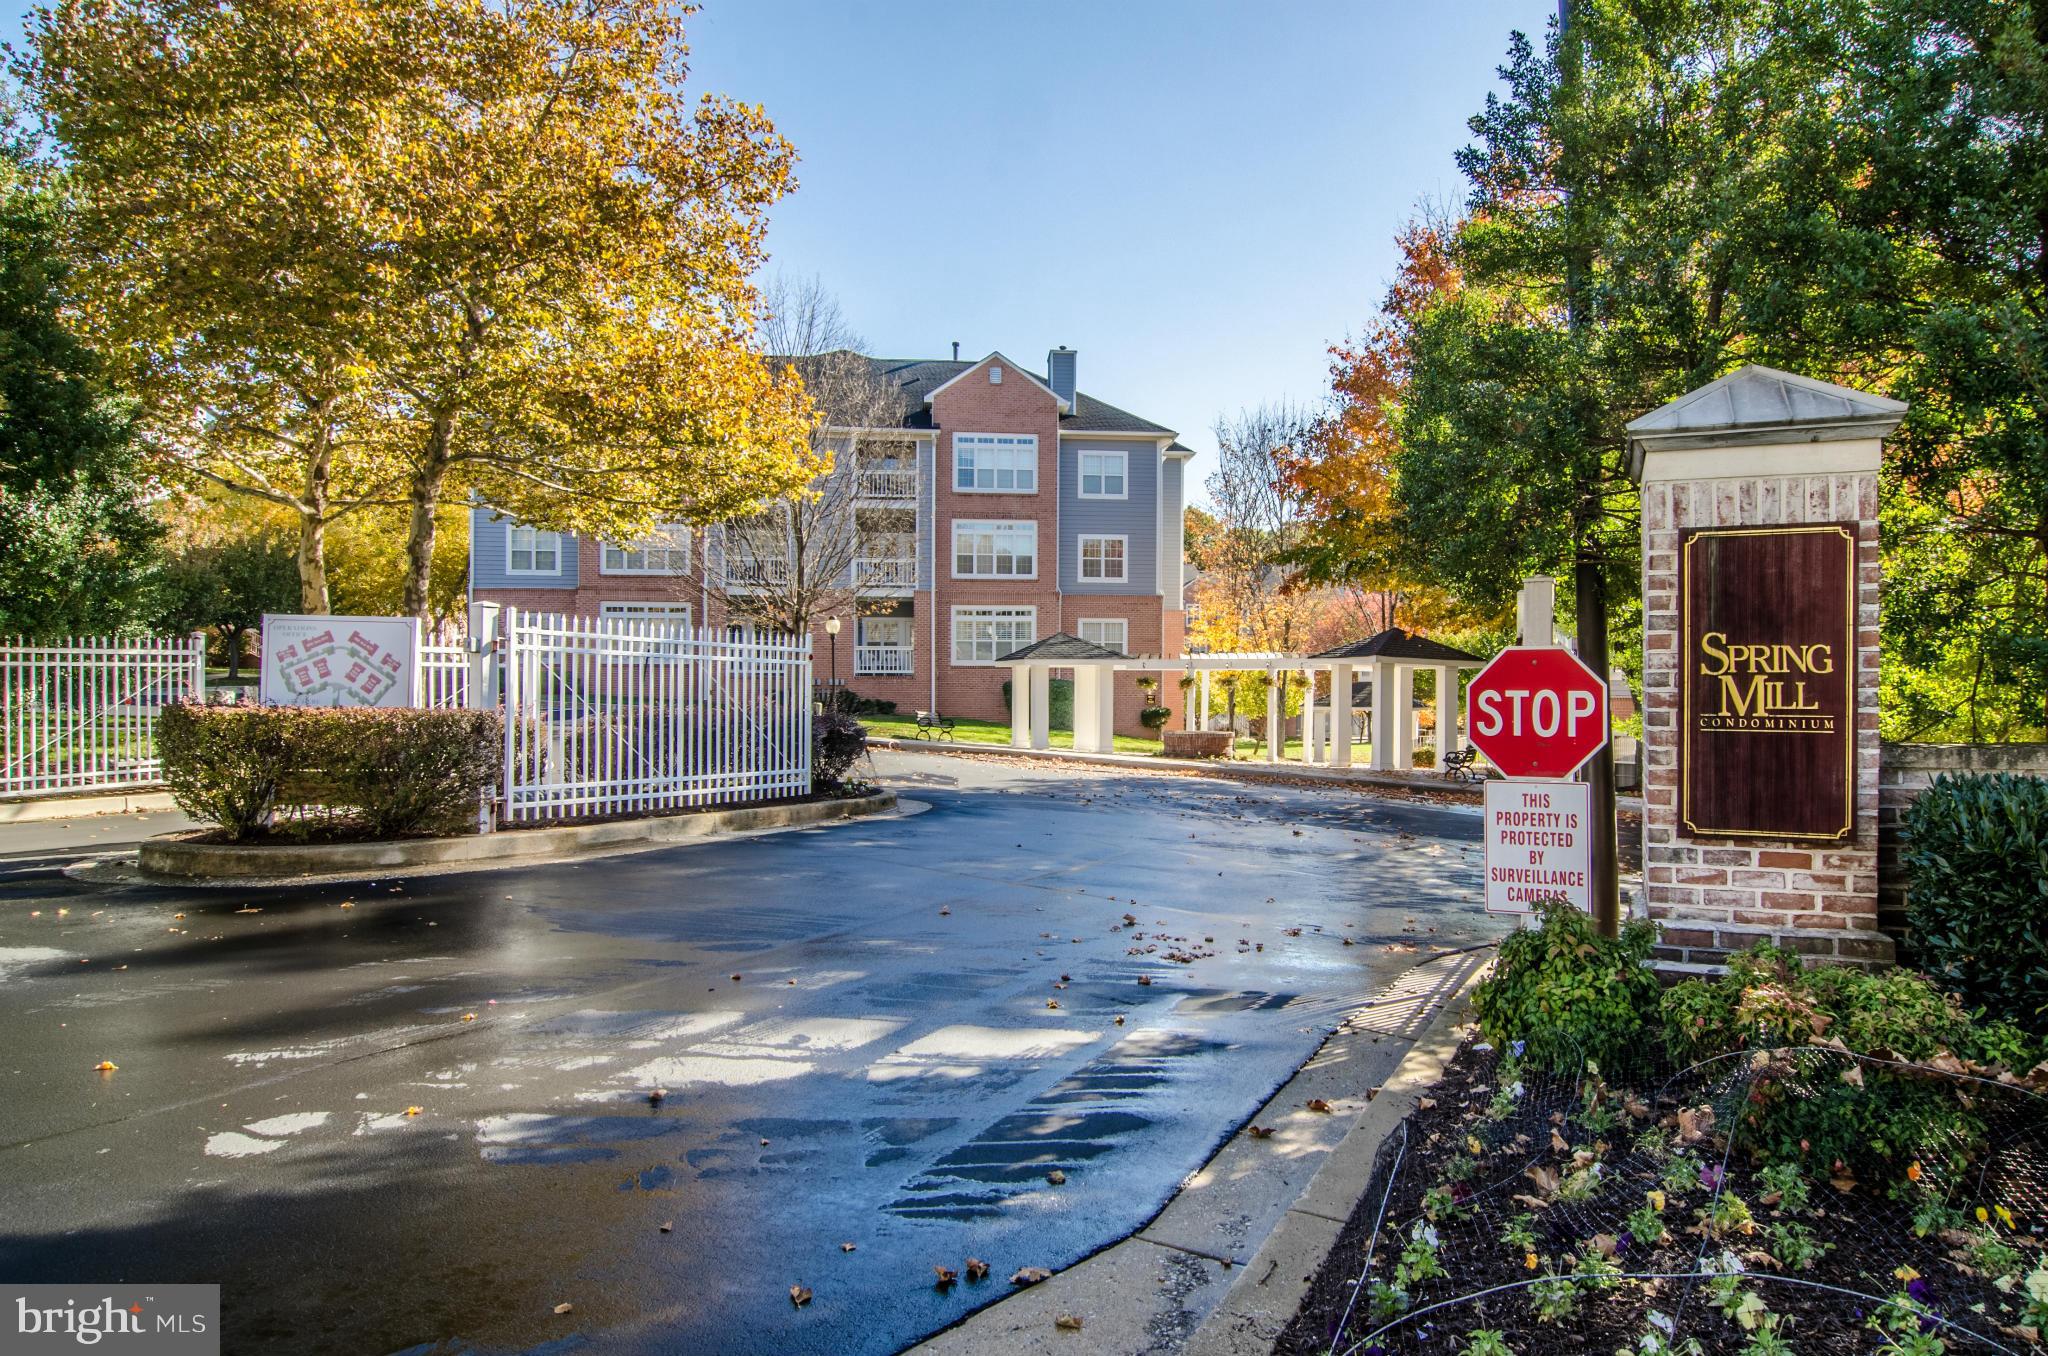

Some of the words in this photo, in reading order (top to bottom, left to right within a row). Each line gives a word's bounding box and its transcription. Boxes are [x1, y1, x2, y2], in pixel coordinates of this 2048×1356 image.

[1700, 632, 1833, 676] SPRING
[1718, 675, 1819, 717] MILL
[1476, 689, 1596, 738] STOP
[1699, 717, 1835, 730] CONDOMINIUM
[1522, 793, 1550, 809] THIS
[1496, 811, 1561, 829] PROPERTY
[1566, 813, 1578, 829] IS
[1500, 829, 1574, 848] PROTECTED
[1529, 850, 1545, 865] BY
[1491, 867, 1584, 887] SURVEILLANCE
